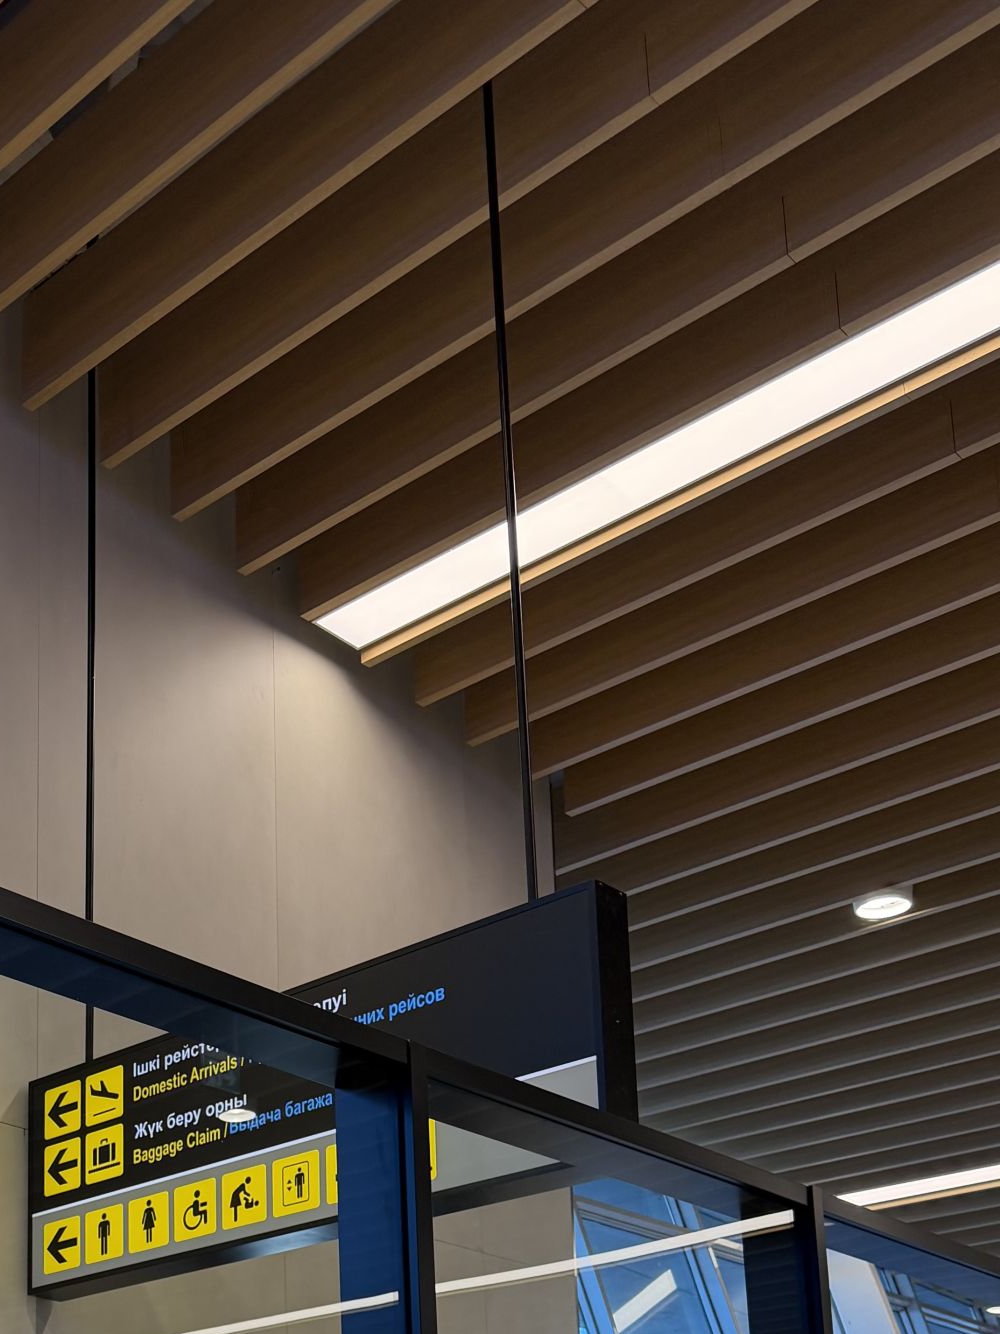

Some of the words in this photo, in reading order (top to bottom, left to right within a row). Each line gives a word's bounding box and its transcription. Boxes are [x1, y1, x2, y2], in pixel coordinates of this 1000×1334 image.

[388, 987, 446, 1021] рейсов
[133, 1055, 160, 1077] Ішкі
[164, 1043, 219, 1070] рейст
[133, 1072, 188, 1102] Domestic
[190, 1055, 238, 1083] Arrivals
[133, 1139, 184, 1165] Baggage
[186, 1127, 221, 1147] Claim
[284, 1092, 334, 1118] багажа
[134, 1119, 163, 1139] Жүк
[167, 1107, 201, 1130] беру
[205, 1093, 248, 1118] орны
